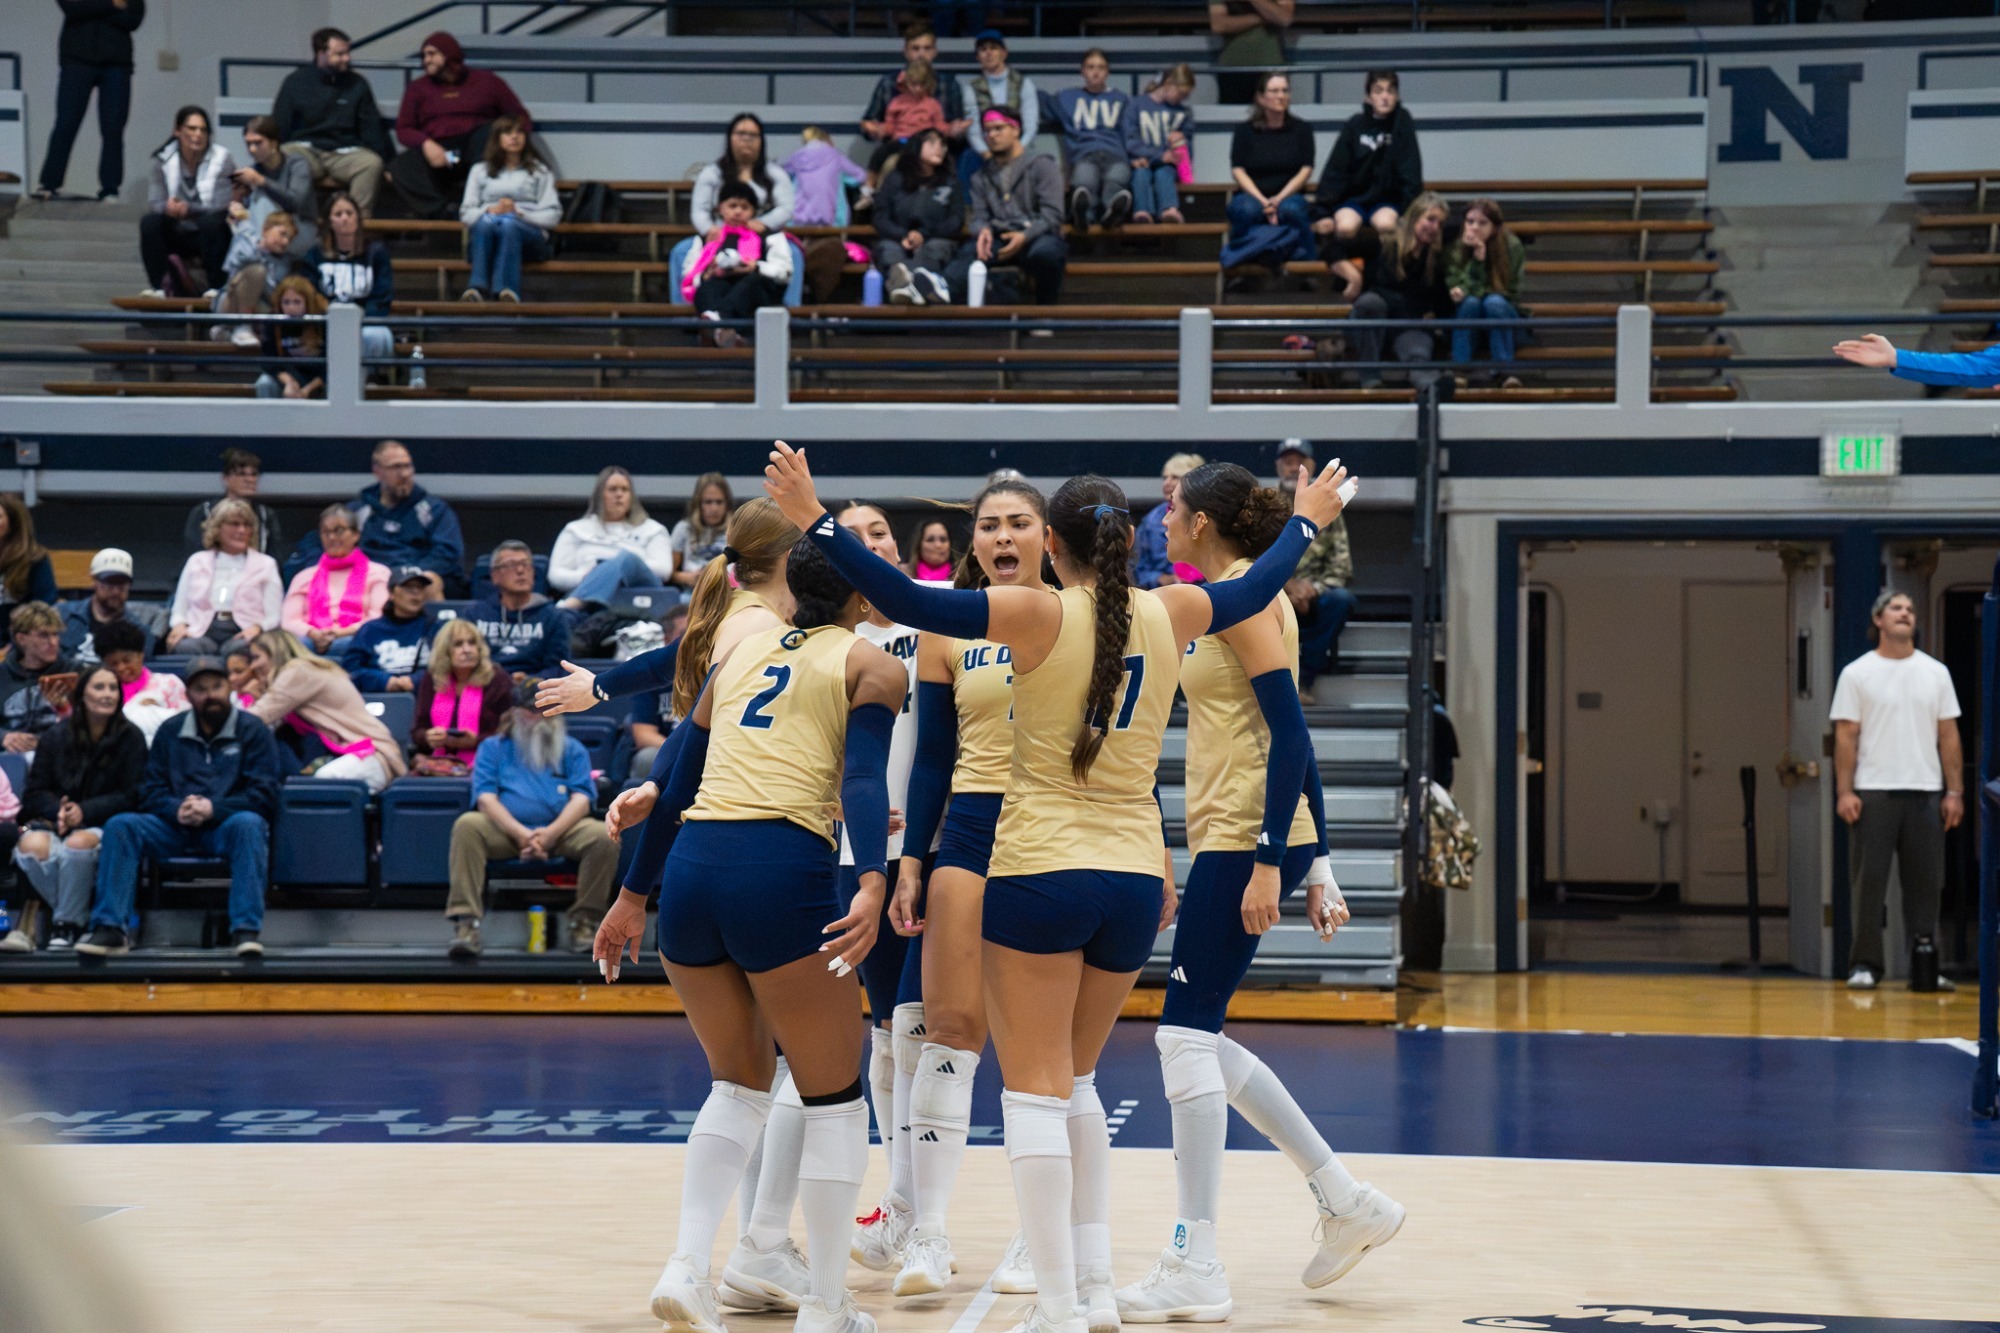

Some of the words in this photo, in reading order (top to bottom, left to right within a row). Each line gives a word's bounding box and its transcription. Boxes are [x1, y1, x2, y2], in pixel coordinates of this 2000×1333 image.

[1073, 98, 1121, 130] NV
[1139, 110, 1185, 146] NV
[1717, 62, 1864, 163] N
[1838, 436, 1885, 470] EXIT
[475, 619, 545, 639] NEVADA
[963, 646, 992, 672] UC
[738, 664, 792, 731] 2
